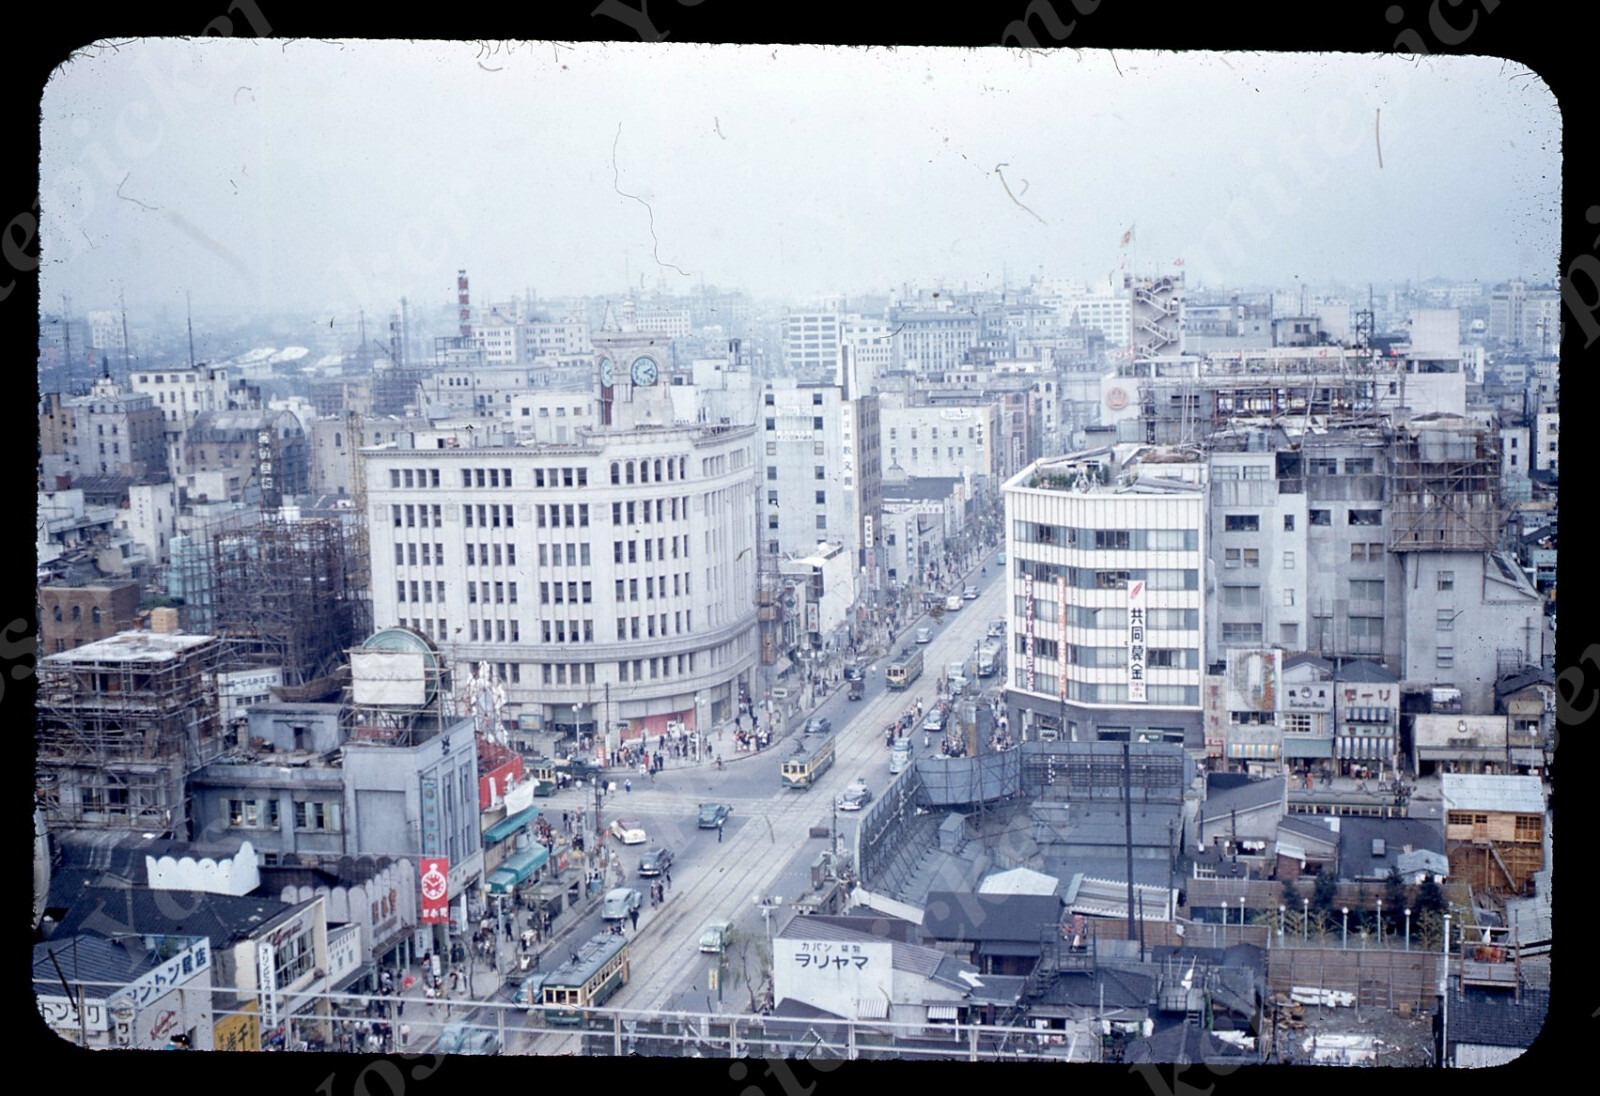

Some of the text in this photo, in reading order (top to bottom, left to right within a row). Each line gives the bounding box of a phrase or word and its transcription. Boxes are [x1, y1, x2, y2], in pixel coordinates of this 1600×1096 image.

[1131, 607, 1144, 680] 共同募金
[802, 943, 832, 952] カバン
